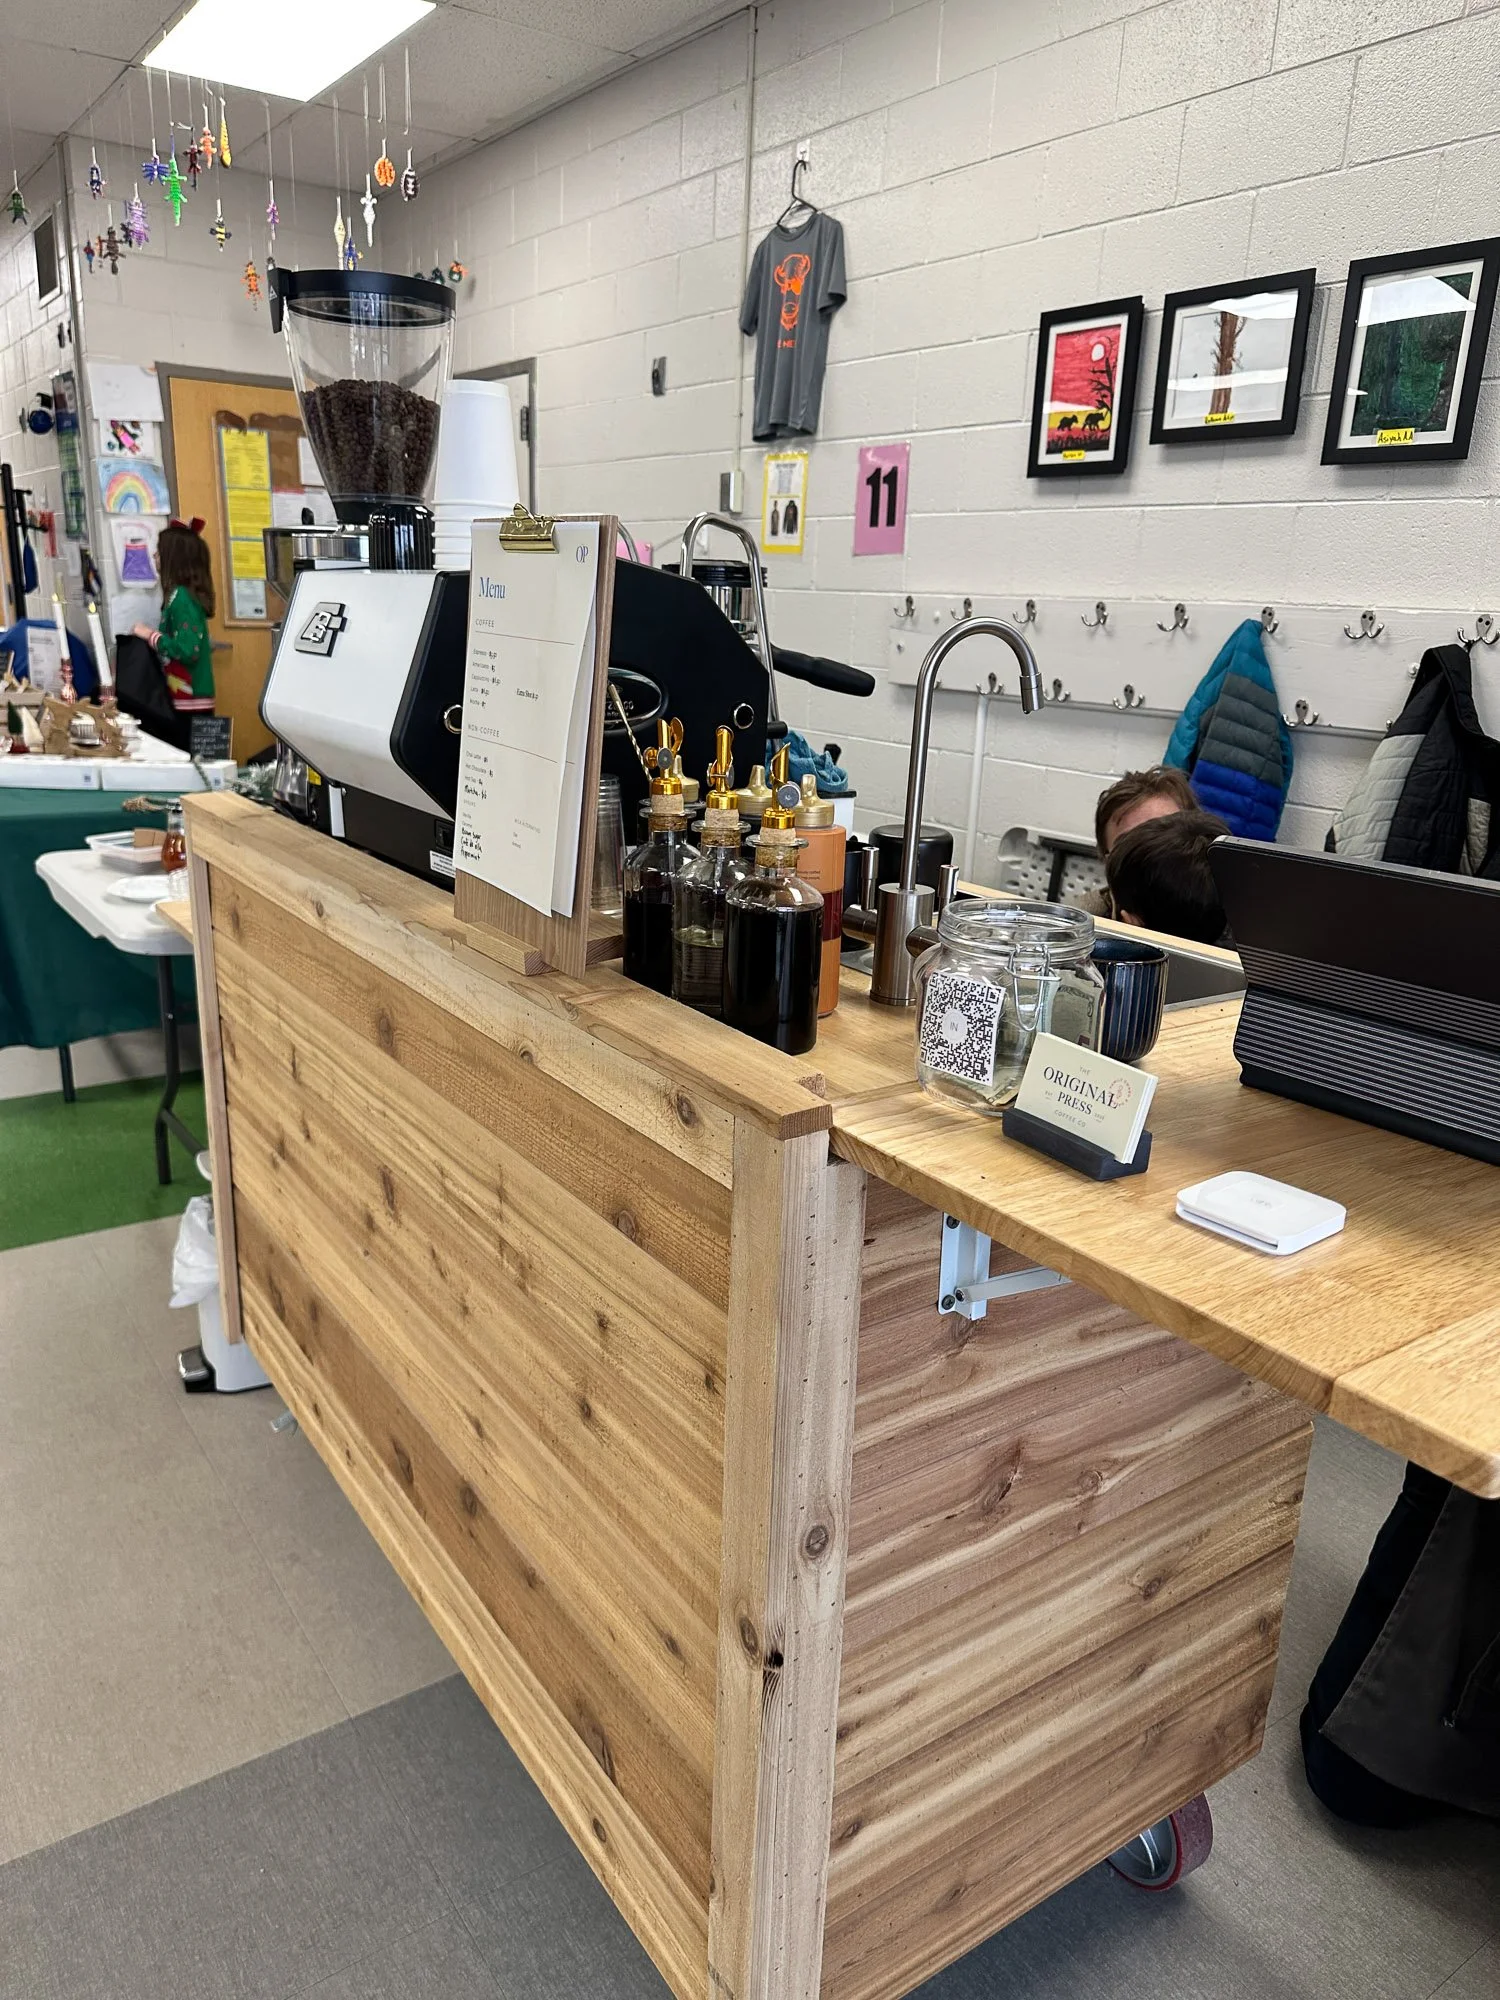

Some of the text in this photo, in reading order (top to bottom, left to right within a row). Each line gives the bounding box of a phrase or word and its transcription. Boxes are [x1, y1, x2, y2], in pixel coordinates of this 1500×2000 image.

[866, 466, 898, 528] 11
[576, 545, 589, 563] OP
[479, 577, 506, 599] Menu
[475, 618, 495, 628] COFFEE
[949, 1022, 959, 1032] IN
[1079, 1066, 1091, 1075] THE
[1043, 1066, 1118, 1109] ORIGINAL
[1057, 1091, 1093, 1115] PRESS
[1054, 1109, 1076, 1123] COFFEE
